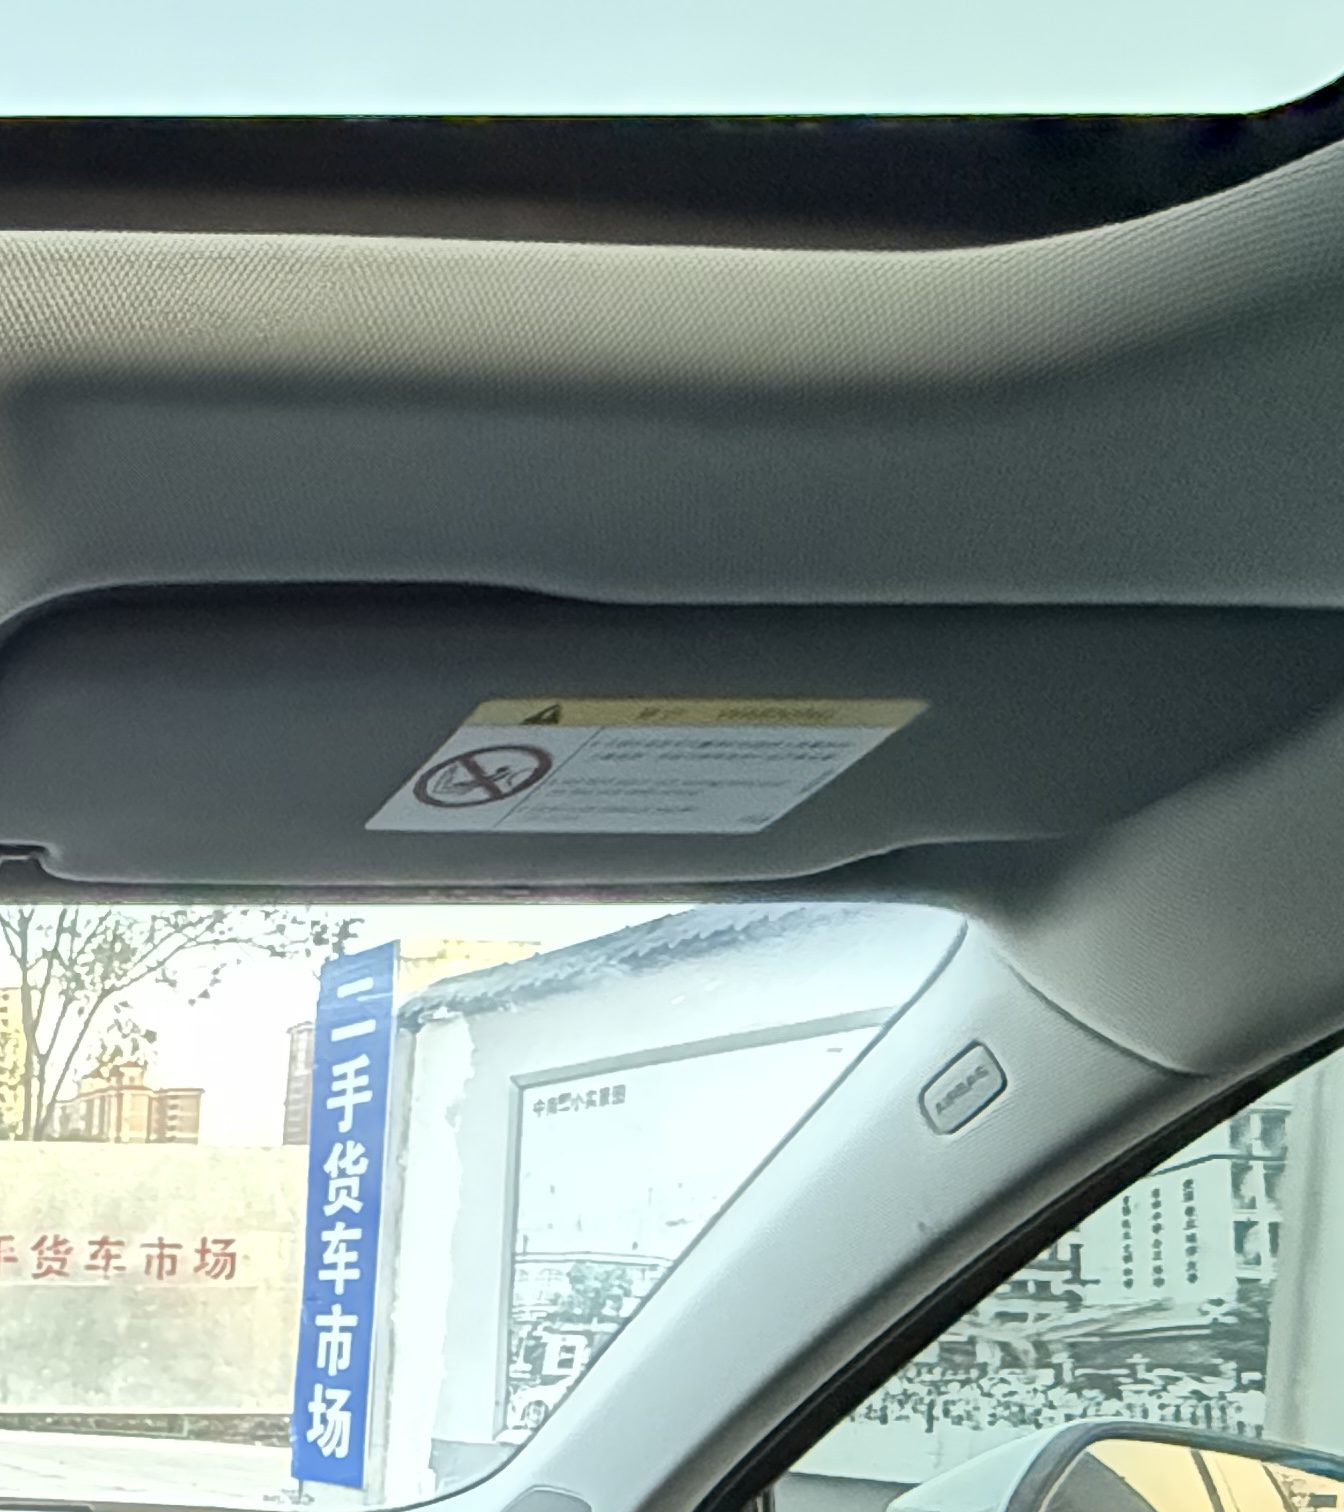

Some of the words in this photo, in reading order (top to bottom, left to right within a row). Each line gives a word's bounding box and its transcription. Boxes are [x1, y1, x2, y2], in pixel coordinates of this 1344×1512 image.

[306, 976, 379, 1459] 二手货车市场
